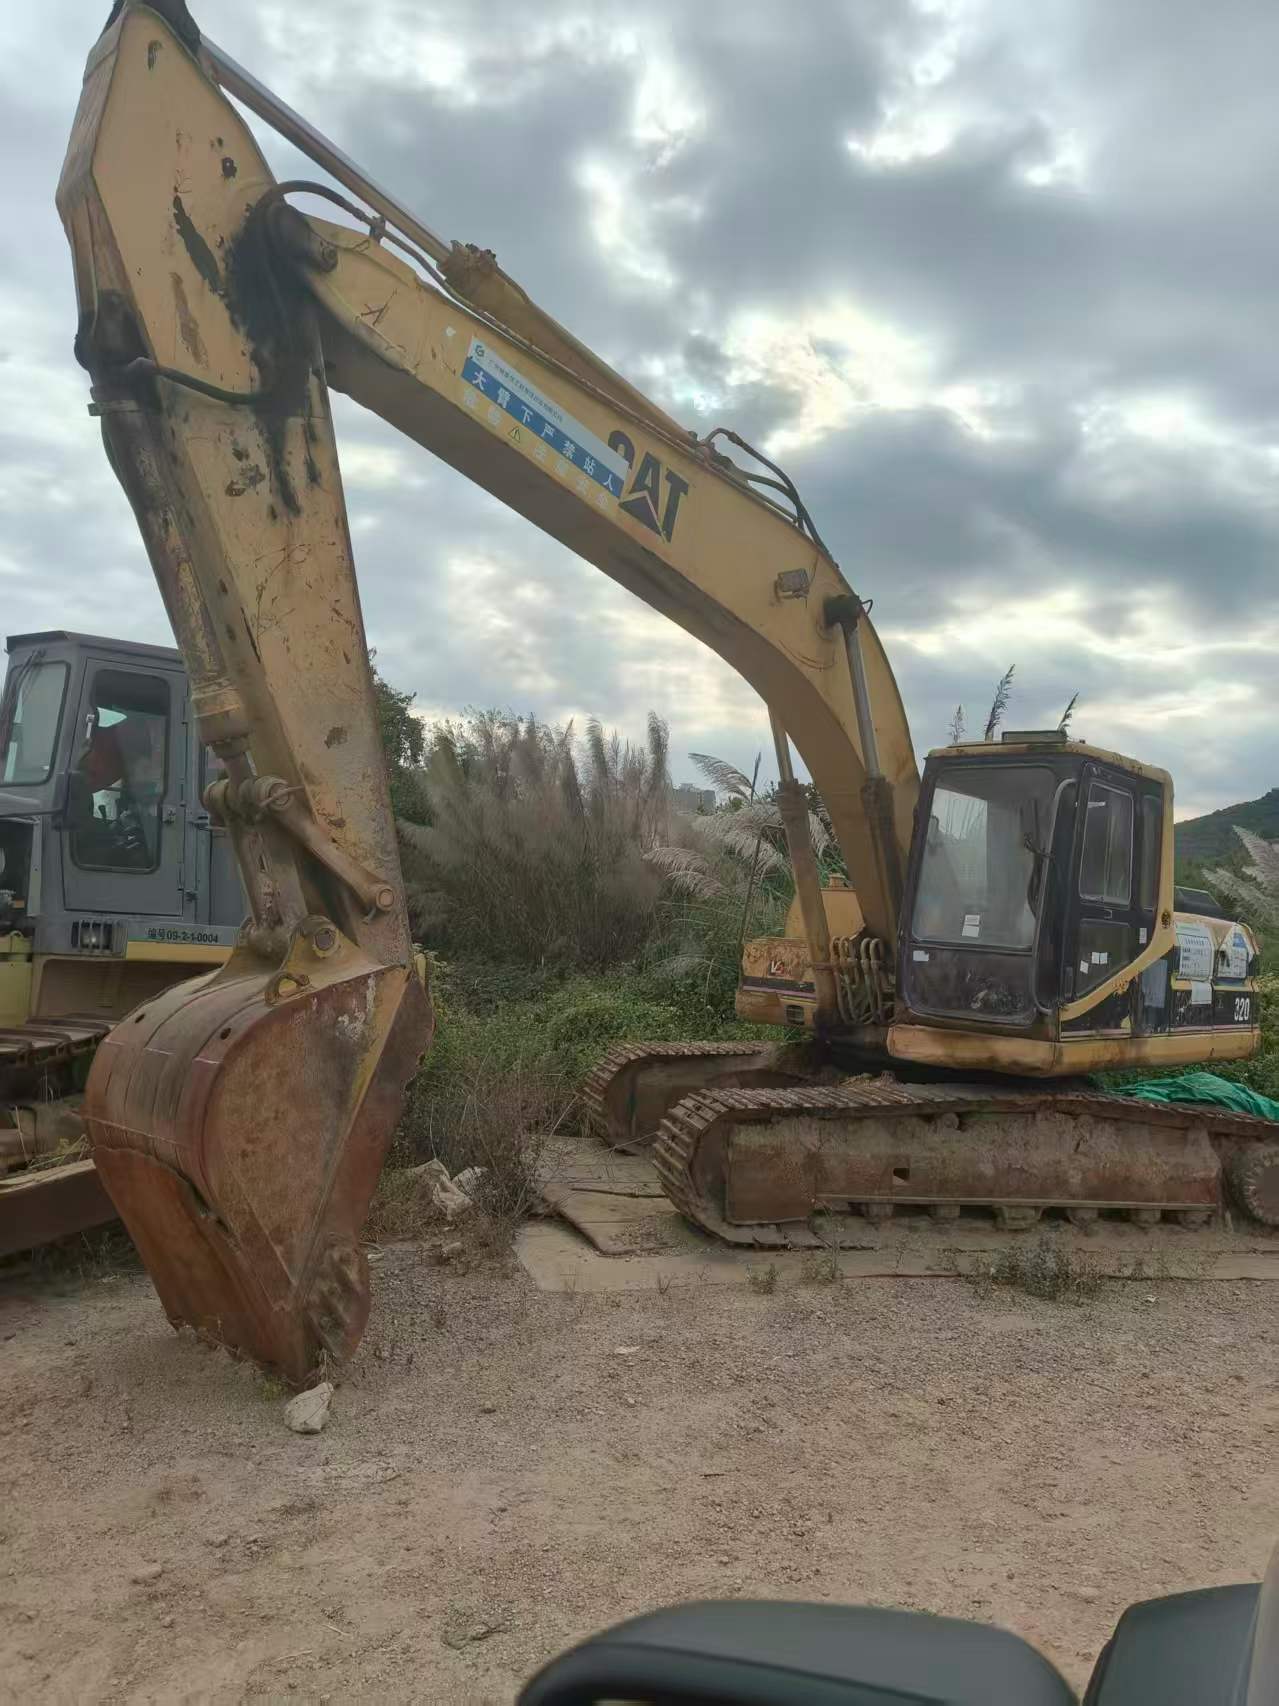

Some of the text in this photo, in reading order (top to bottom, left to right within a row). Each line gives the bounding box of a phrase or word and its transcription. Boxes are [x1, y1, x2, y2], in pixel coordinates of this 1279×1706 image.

[472, 370, 613, 491] 大臂下严禁站人
[1234, 997, 1250, 1021] 320
